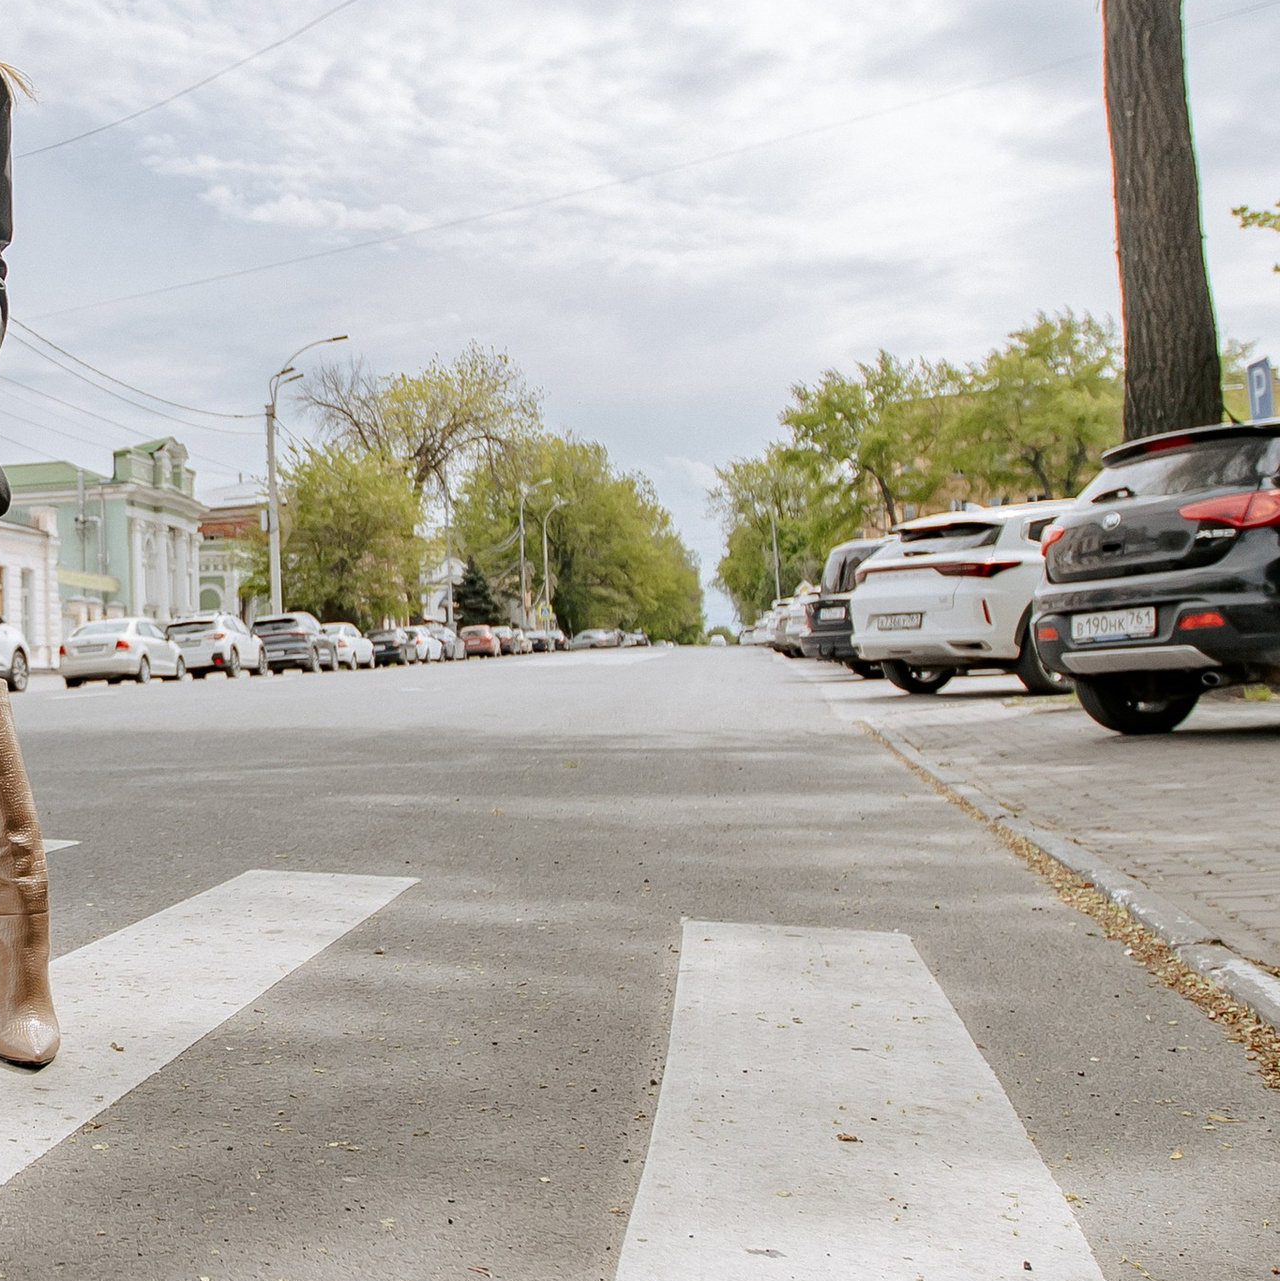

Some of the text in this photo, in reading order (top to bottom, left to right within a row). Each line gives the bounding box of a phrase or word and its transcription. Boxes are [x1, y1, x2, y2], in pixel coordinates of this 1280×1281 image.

[1253, 367, 1266, 415] P
[1076, 610, 1152, 637] В190НК 761
